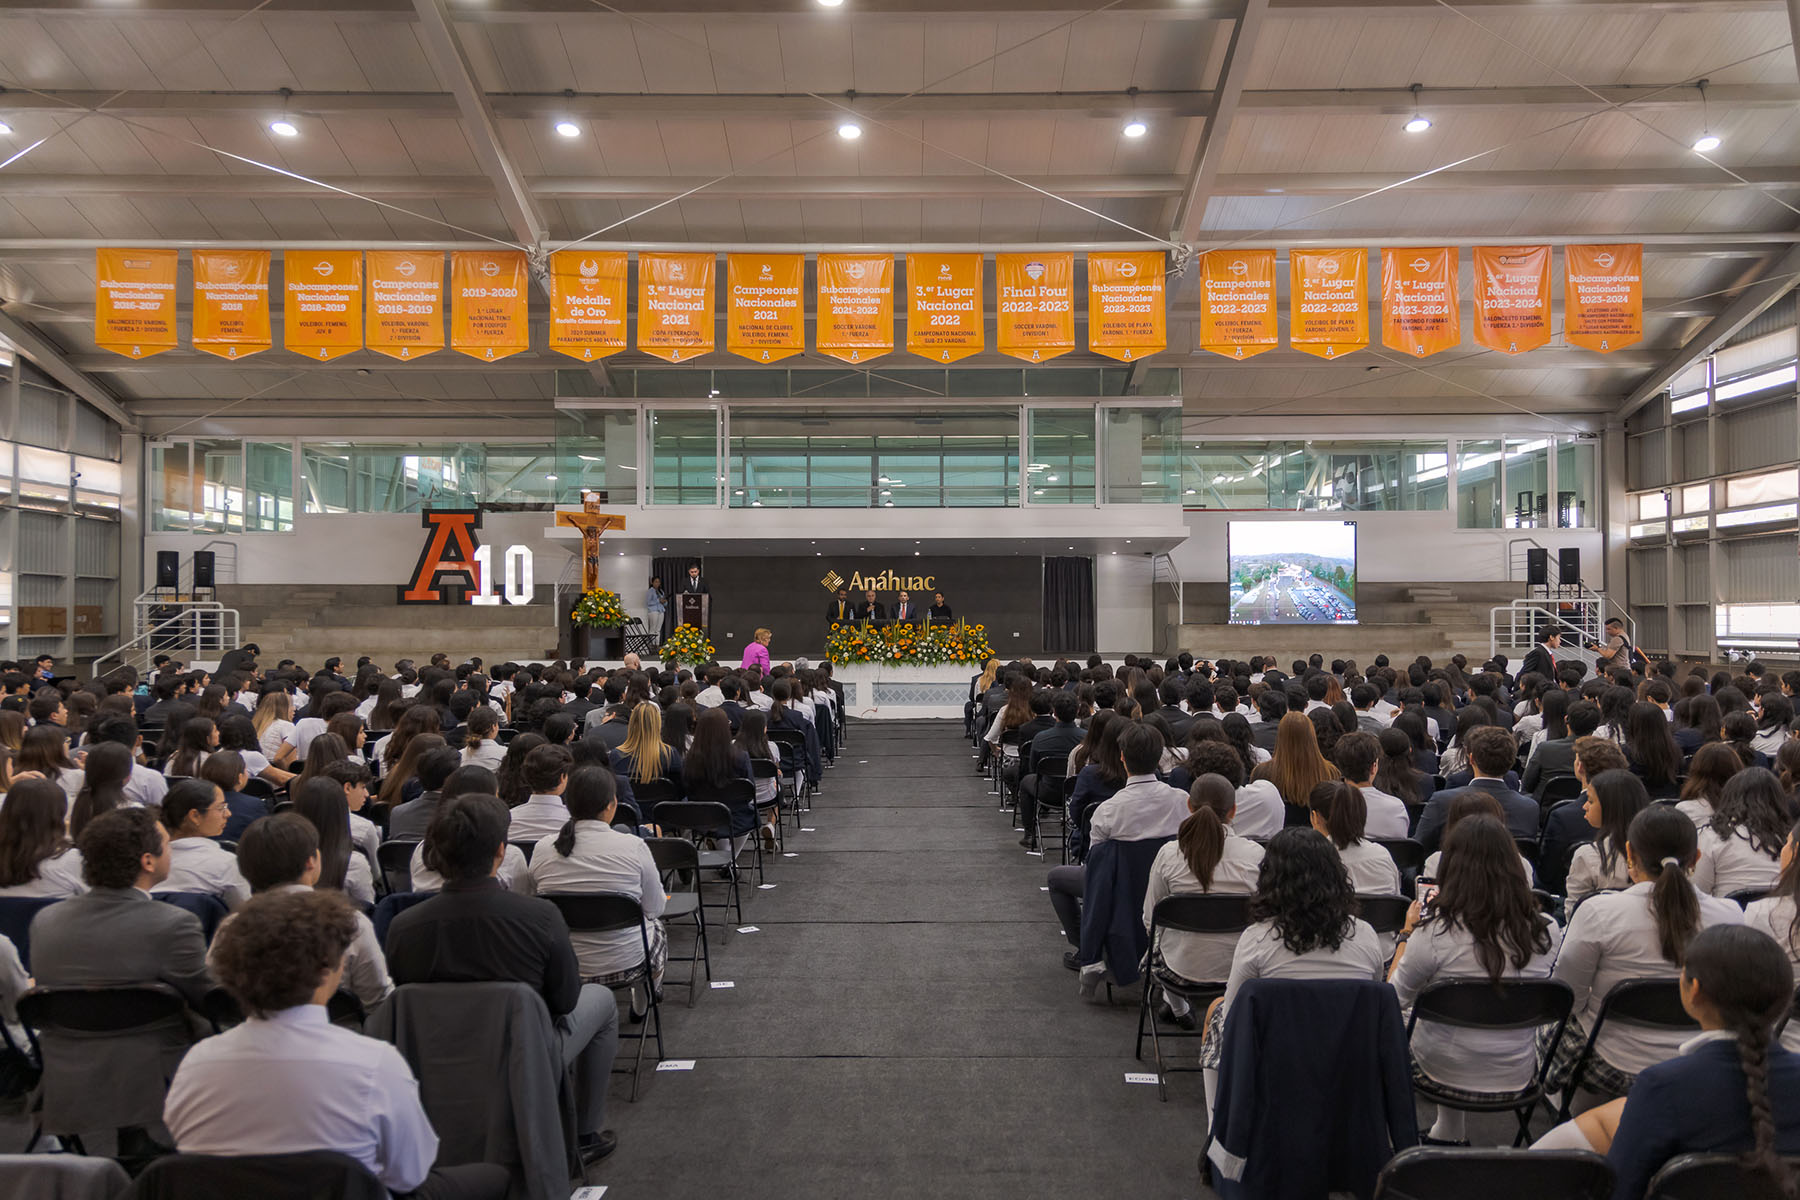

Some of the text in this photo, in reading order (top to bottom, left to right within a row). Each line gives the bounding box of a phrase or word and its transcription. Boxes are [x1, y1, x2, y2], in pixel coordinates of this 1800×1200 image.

[1322, 278, 1354, 289] Lugar
[1506, 274, 1538, 284] Lugar
[1569, 275, 1639, 284] Subcampeones
[100, 280, 174, 290] Subcampeones
[196, 282, 268, 291] Subcampeones
[289, 283, 358, 292] Subcampeones
[373, 280, 439, 290] Campeones
[1092, 284, 1161, 293] Subcampeones
[1205, 280, 1270, 290] Campeones
[1412, 280, 1445, 291] Lugar
[1578, 285, 1630, 293] Nacionales
[110, 291, 164, 299] Nacionales
[462, 288, 517, 297] 2019-2020
[668, 286, 706, 299] Lugar
[734, 286, 798, 296] Campeones
[821, 286, 890, 295] Subcampeones
[937, 286, 974, 299] Lugar
[1003, 286, 1067, 297] Final Four
[1304, 290, 1354, 300] Nacional
[1487, 286, 1538, 296] Nacional
[374, 292, 436, 301] Nacionales
[566, 296, 610, 304] Medalla
[830, 296, 880, 304] Nacionales
[1102, 294, 1152, 302] Nacionales
[1208, 291, 1269, 301] Nacionales
[1396, 292, 1445, 302] Nacional
[1580, 295, 1628, 304] 2023-2024
[648, 300, 704, 310] Nacional
[736, 298, 796, 307] Nacionales
[917, 300, 974, 310] Nacional
[1002, 301, 1069, 312] 2022-2023
[1484, 299, 1542, 309] 2023-2024
[378, 305, 432, 314] 2018-2019
[571, 307, 606, 316] de Oro
[1104, 305, 1151, 313] 2022-2023
[1210, 304, 1267, 313] 2022-2023
[1301, 303, 1359, 312] 2022-2023
[1392, 305, 1449, 314] 2023-2024
[662, 314, 690, 325] 2021
[754, 311, 778, 320] 2021
[931, 315, 960, 325] 2022
[1509, 342, 1518, 352] A
[1601, 341, 1608, 349] A
[133, 346, 141, 354] A
[229, 347, 236, 355] A
[320, 348, 328, 356] A
[401, 348, 409, 356] A
[486, 349, 494, 357] A
[584, 349, 592, 357] A
[672, 350, 680, 358] A
[942, 350, 950, 359] A
[1032, 350, 1040, 359] A
[1124, 349, 1131, 358] A
[1235, 347, 1243, 356] A
[1326, 346, 1334, 355] A
[1416, 346, 1424, 354] A
[762, 351, 770, 359] A
[851, 351, 859, 360] A
[397, 509, 534, 606] A 10
[848, 569, 935, 591] Anáhuac
